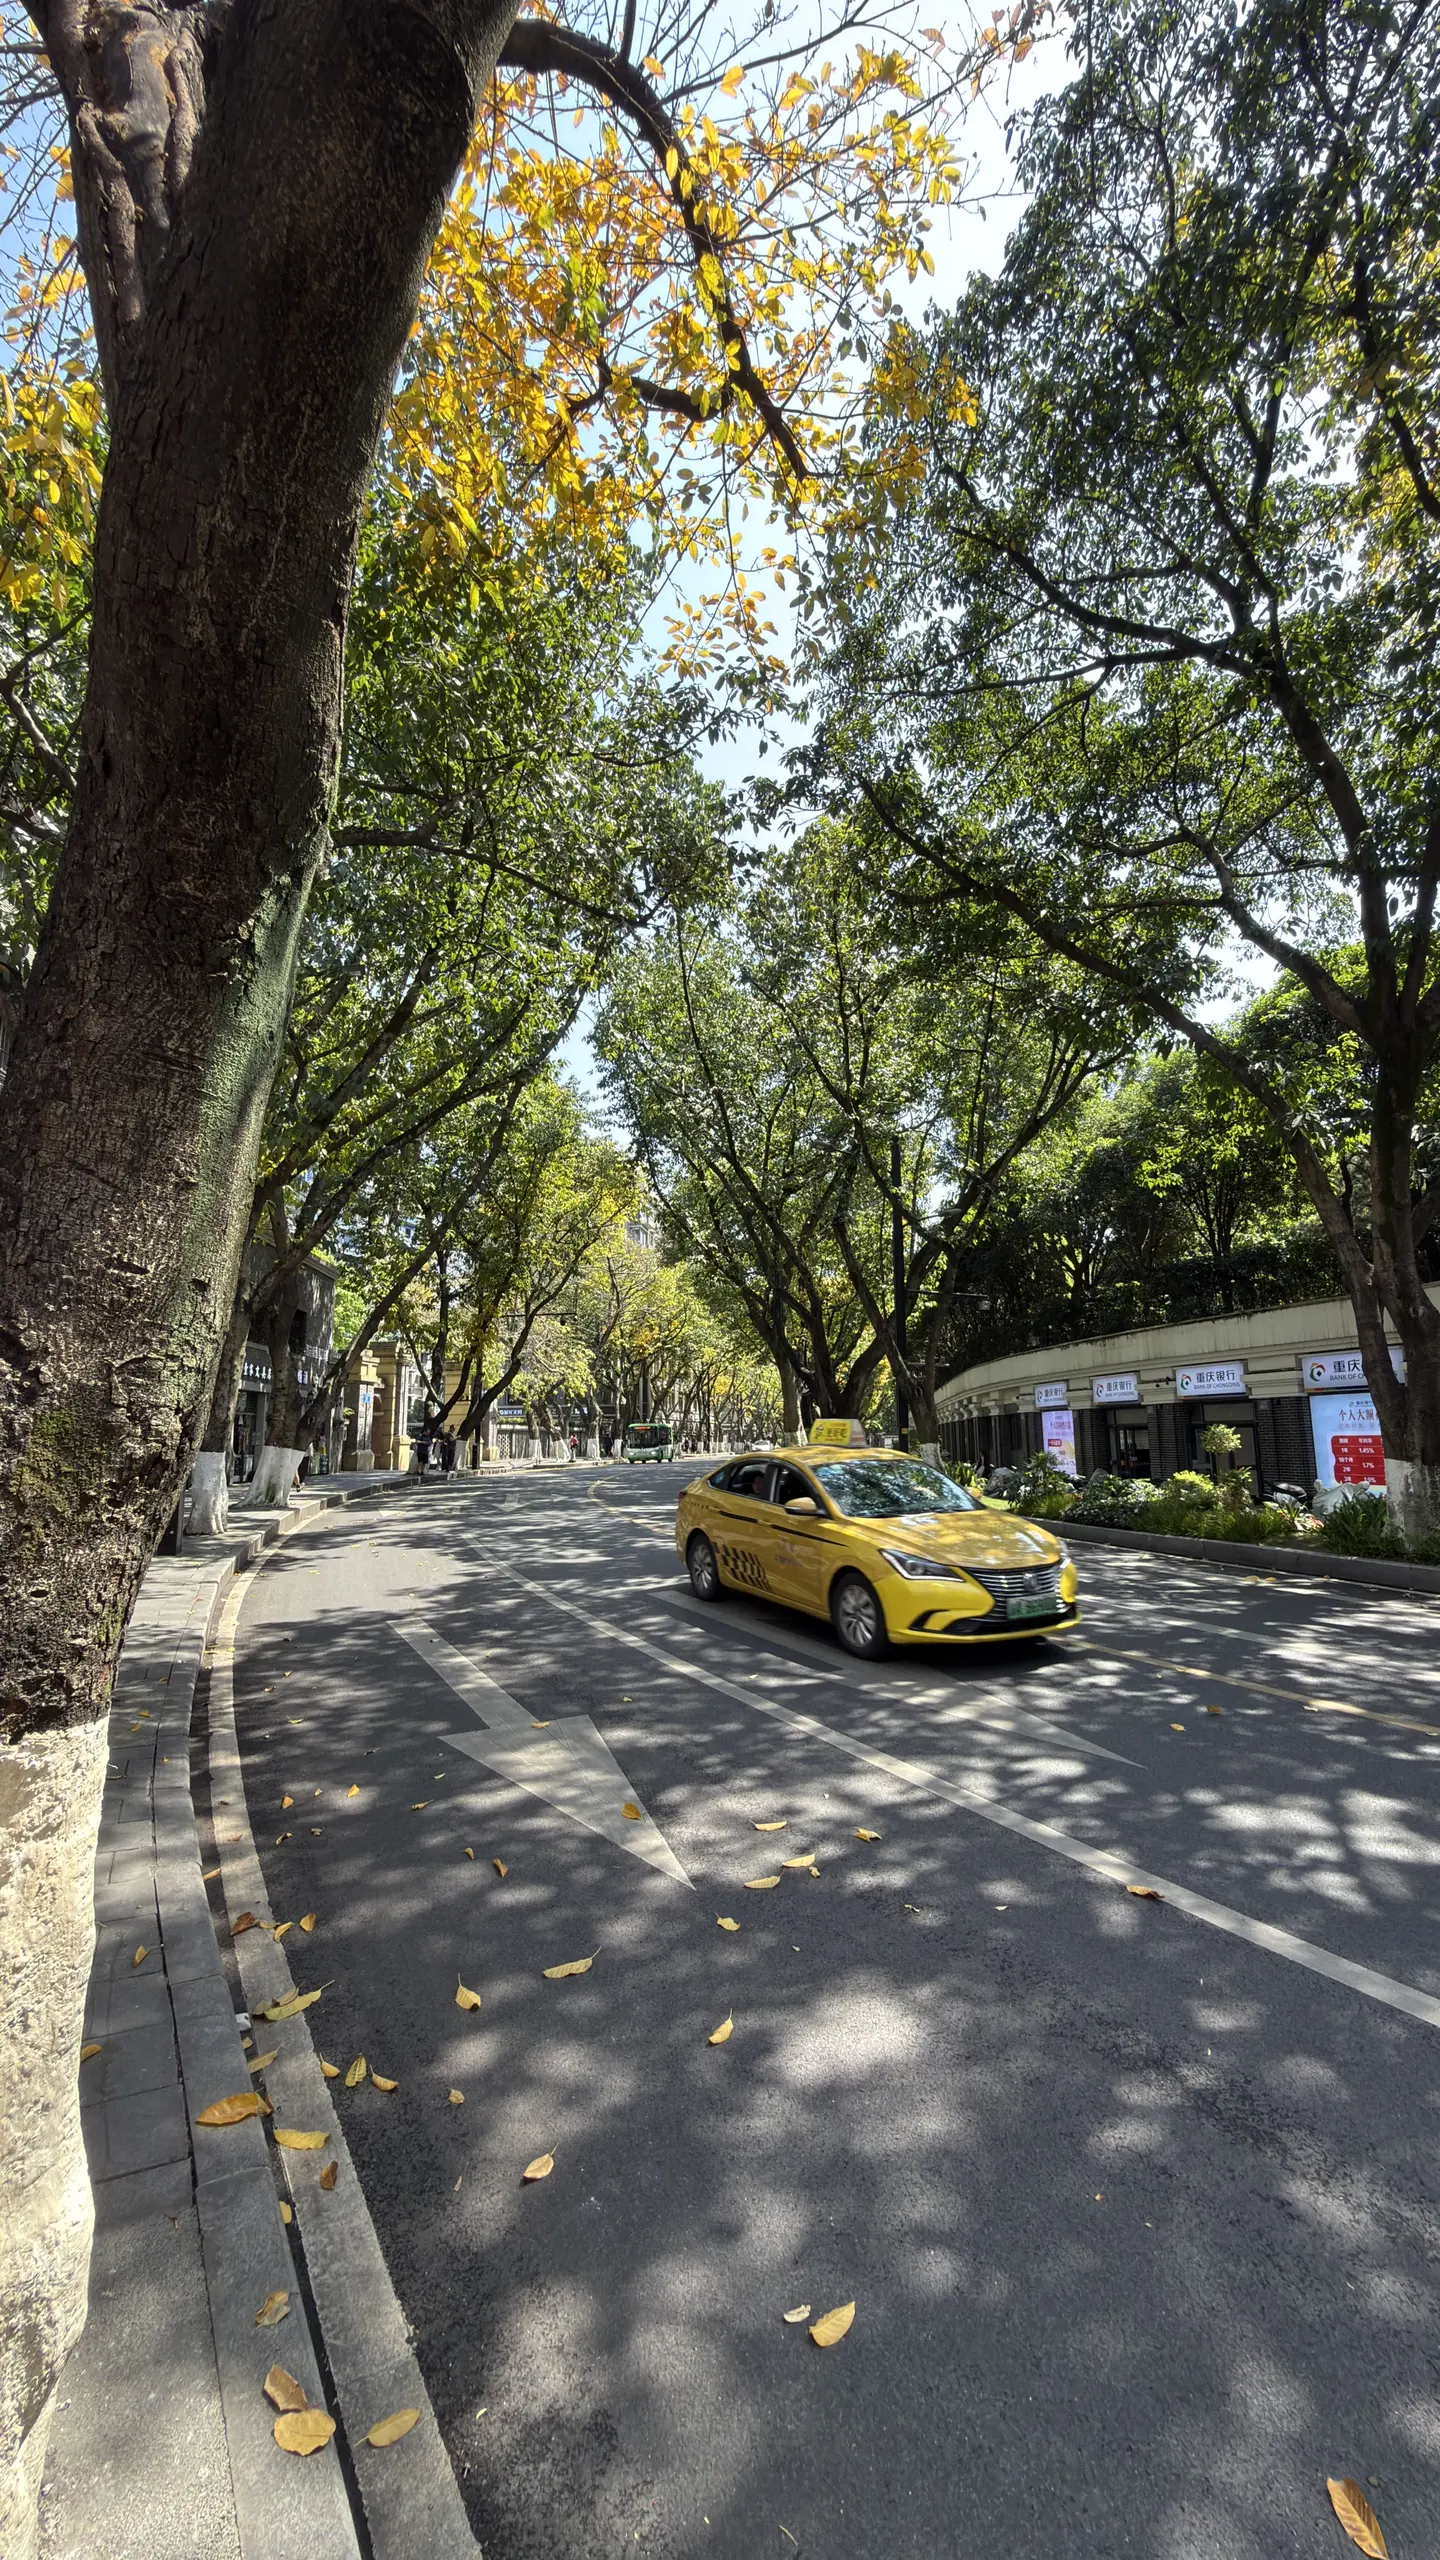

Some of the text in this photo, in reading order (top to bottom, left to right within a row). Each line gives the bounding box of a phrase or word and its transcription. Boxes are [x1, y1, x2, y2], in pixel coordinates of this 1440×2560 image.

[1196, 1369, 1236, 1383] 重庆银行
[1106, 1380, 1132, 1392] 重庆银行
[1339, 1408, 1379, 1421] 个人大额
